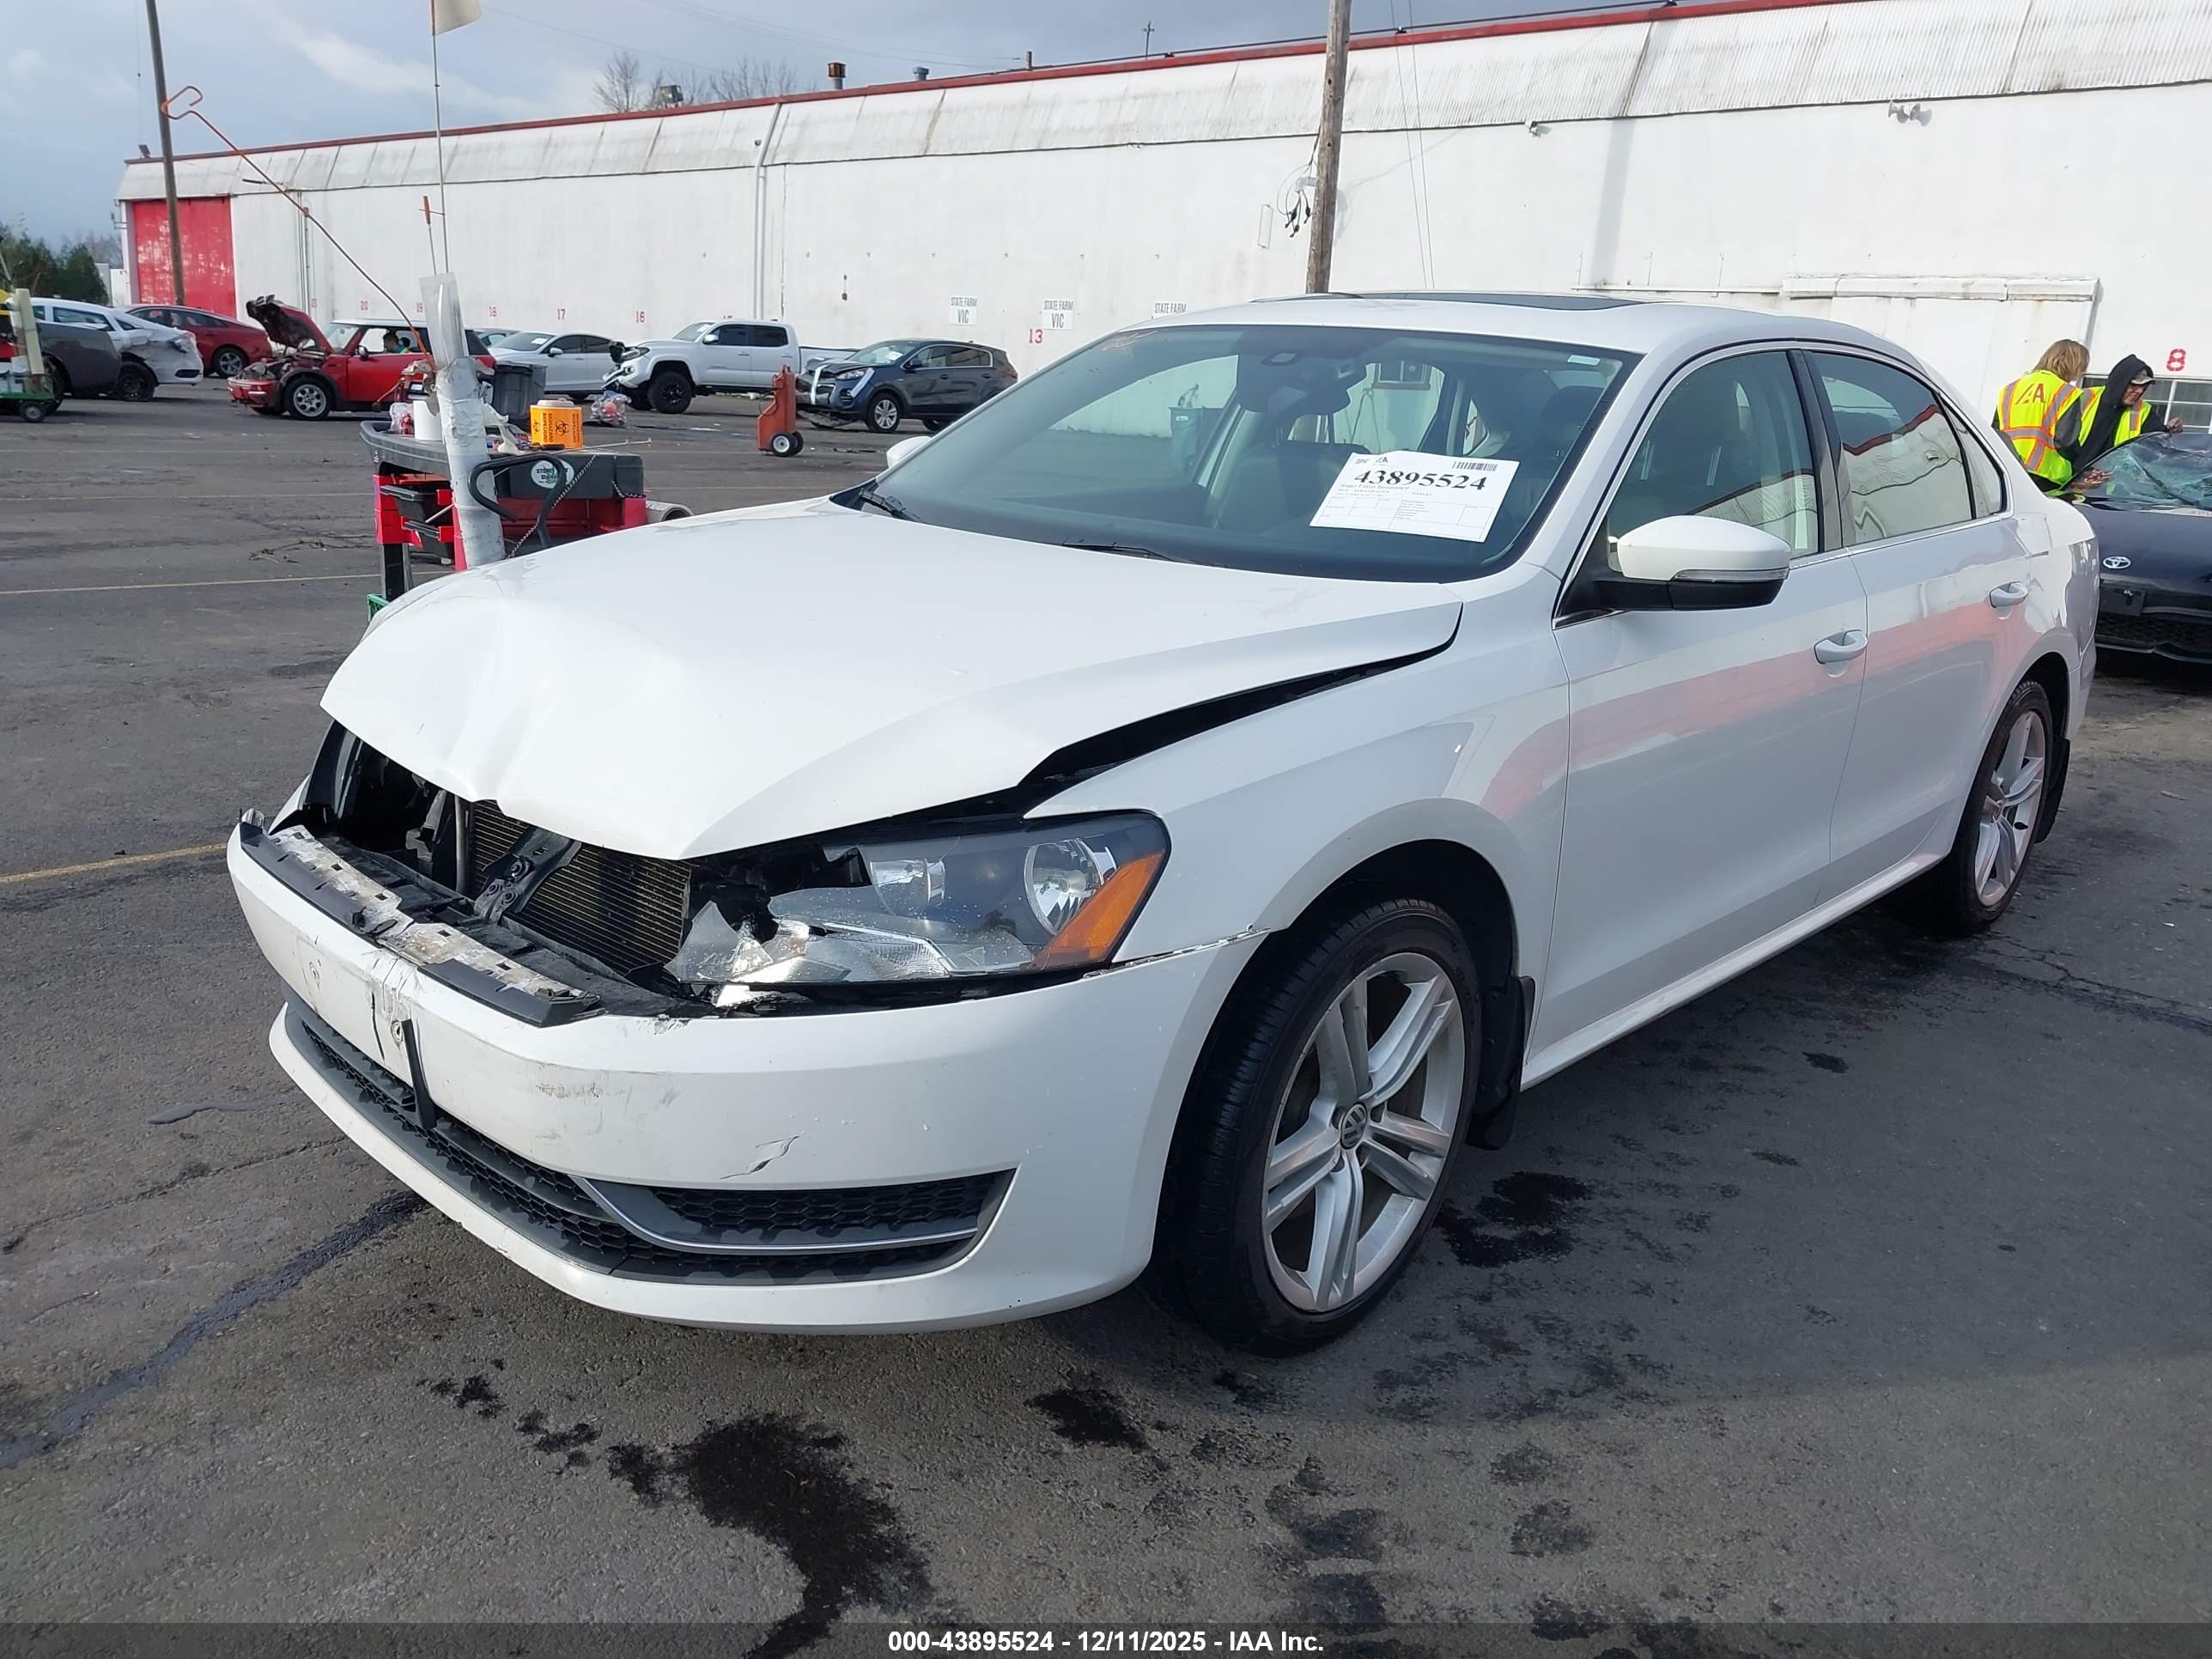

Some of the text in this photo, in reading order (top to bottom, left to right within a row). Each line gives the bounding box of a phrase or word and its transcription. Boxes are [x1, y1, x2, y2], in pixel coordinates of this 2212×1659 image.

[951, 297, 977, 307] STATE FARM
[1044, 301, 1073, 310] STATE FARM
[1155, 302, 1170, 313] STATE
[557, 309, 566, 320] 17
[635, 311, 645, 323] 16
[957, 309, 969, 324] VIC
[1051, 313, 1065, 328] VIC
[1029, 328, 1043, 343] 13
[2166, 349, 2186, 372] 8
[1354, 470, 1488, 490] 43895524
